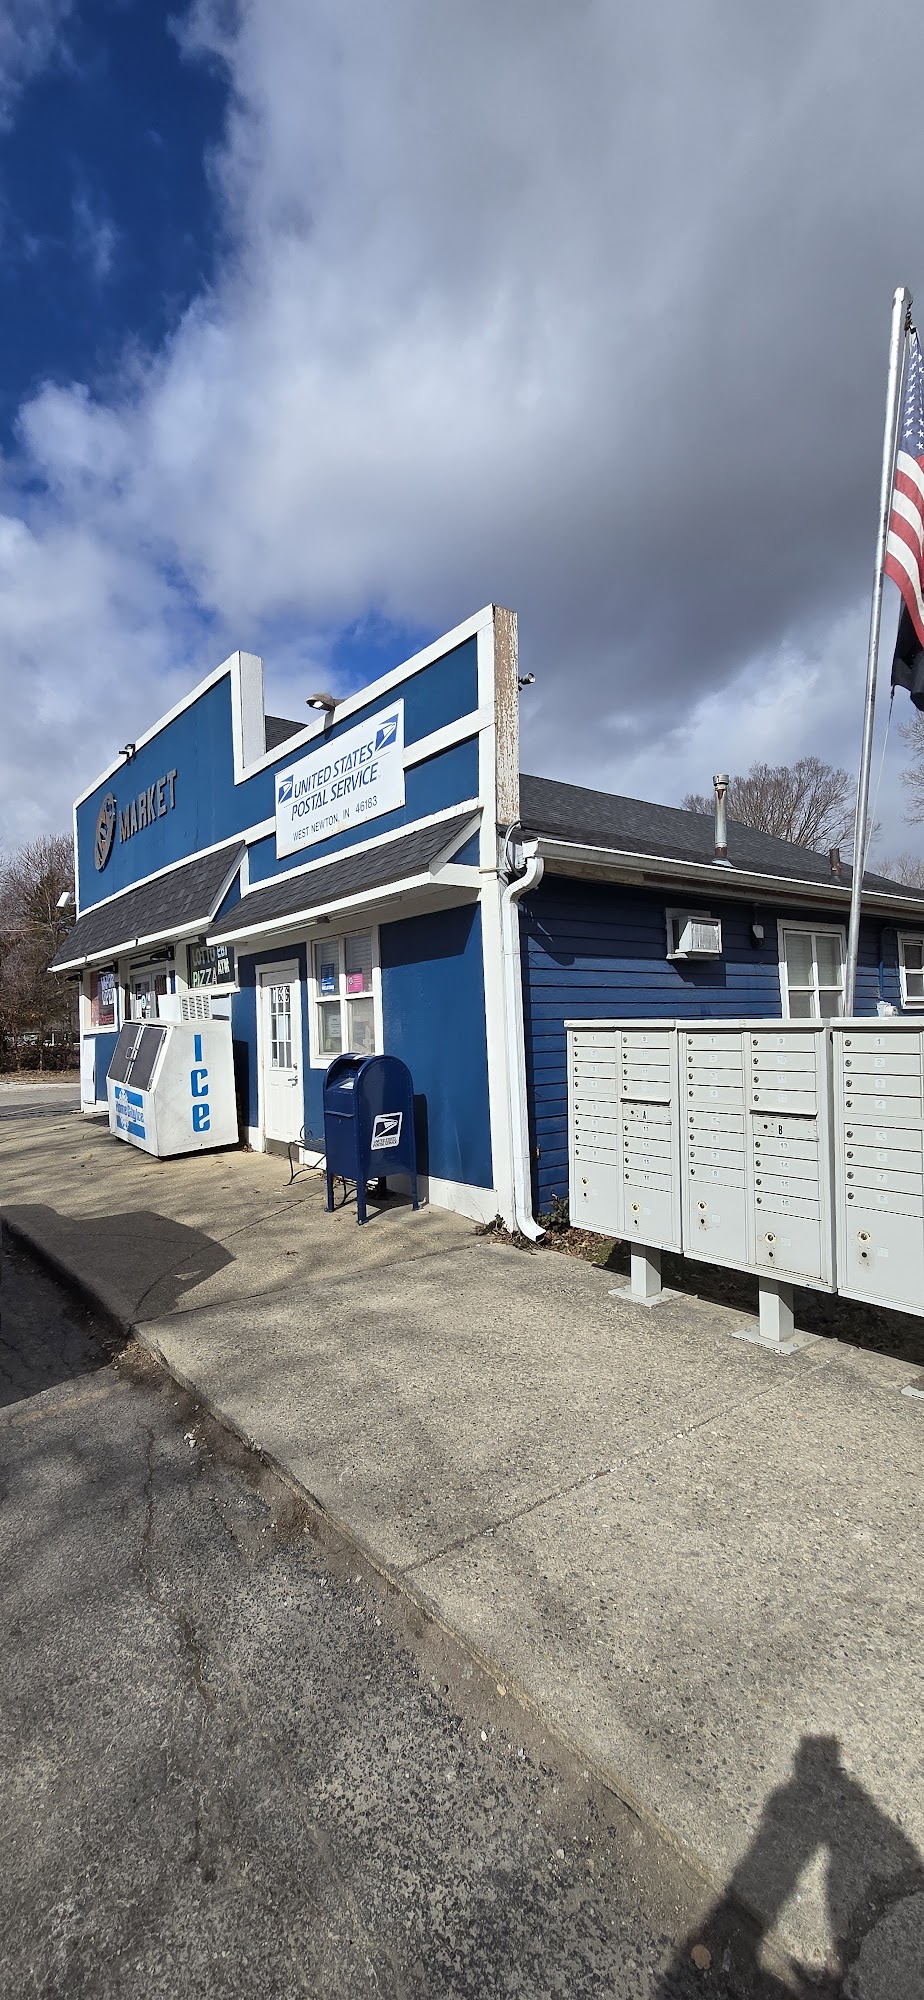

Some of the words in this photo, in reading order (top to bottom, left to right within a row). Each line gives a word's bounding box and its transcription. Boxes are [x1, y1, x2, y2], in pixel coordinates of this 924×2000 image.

[291, 789, 329, 821] POSTAL
[330, 762, 379, 802] SERVICE
[294, 765, 332, 799] UNITED
[332, 740, 374, 779] STATES
[119, 768, 177, 844] MARKET
[292, 827, 310, 842] WEST
[342, 807, 350, 818] IN
[355, 795, 378, 814] 46183
[192, 967, 218, 988] PIZZA
[778, 1124, 783, 1135] B
